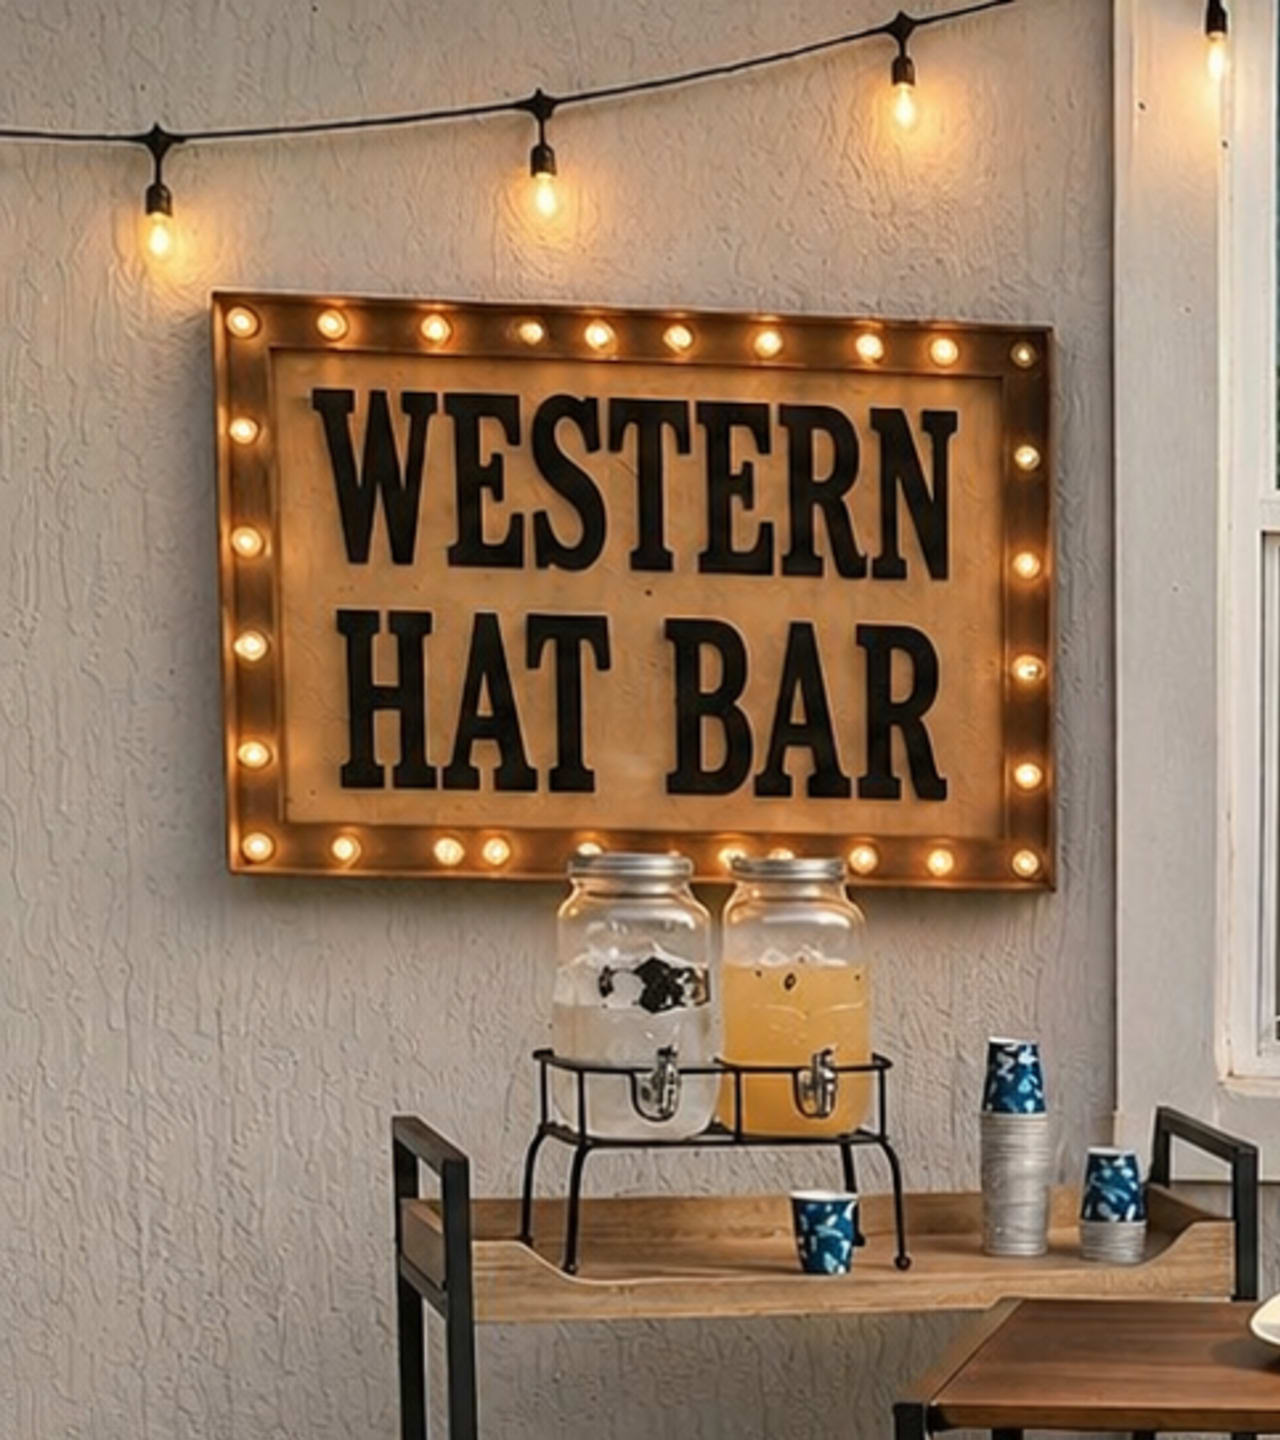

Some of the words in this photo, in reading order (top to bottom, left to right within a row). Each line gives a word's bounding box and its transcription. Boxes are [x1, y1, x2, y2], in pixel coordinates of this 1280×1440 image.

[311, 388, 958, 580] WESTERN
[336, 609, 611, 794] HAT
[664, 617, 947, 801] BAR
